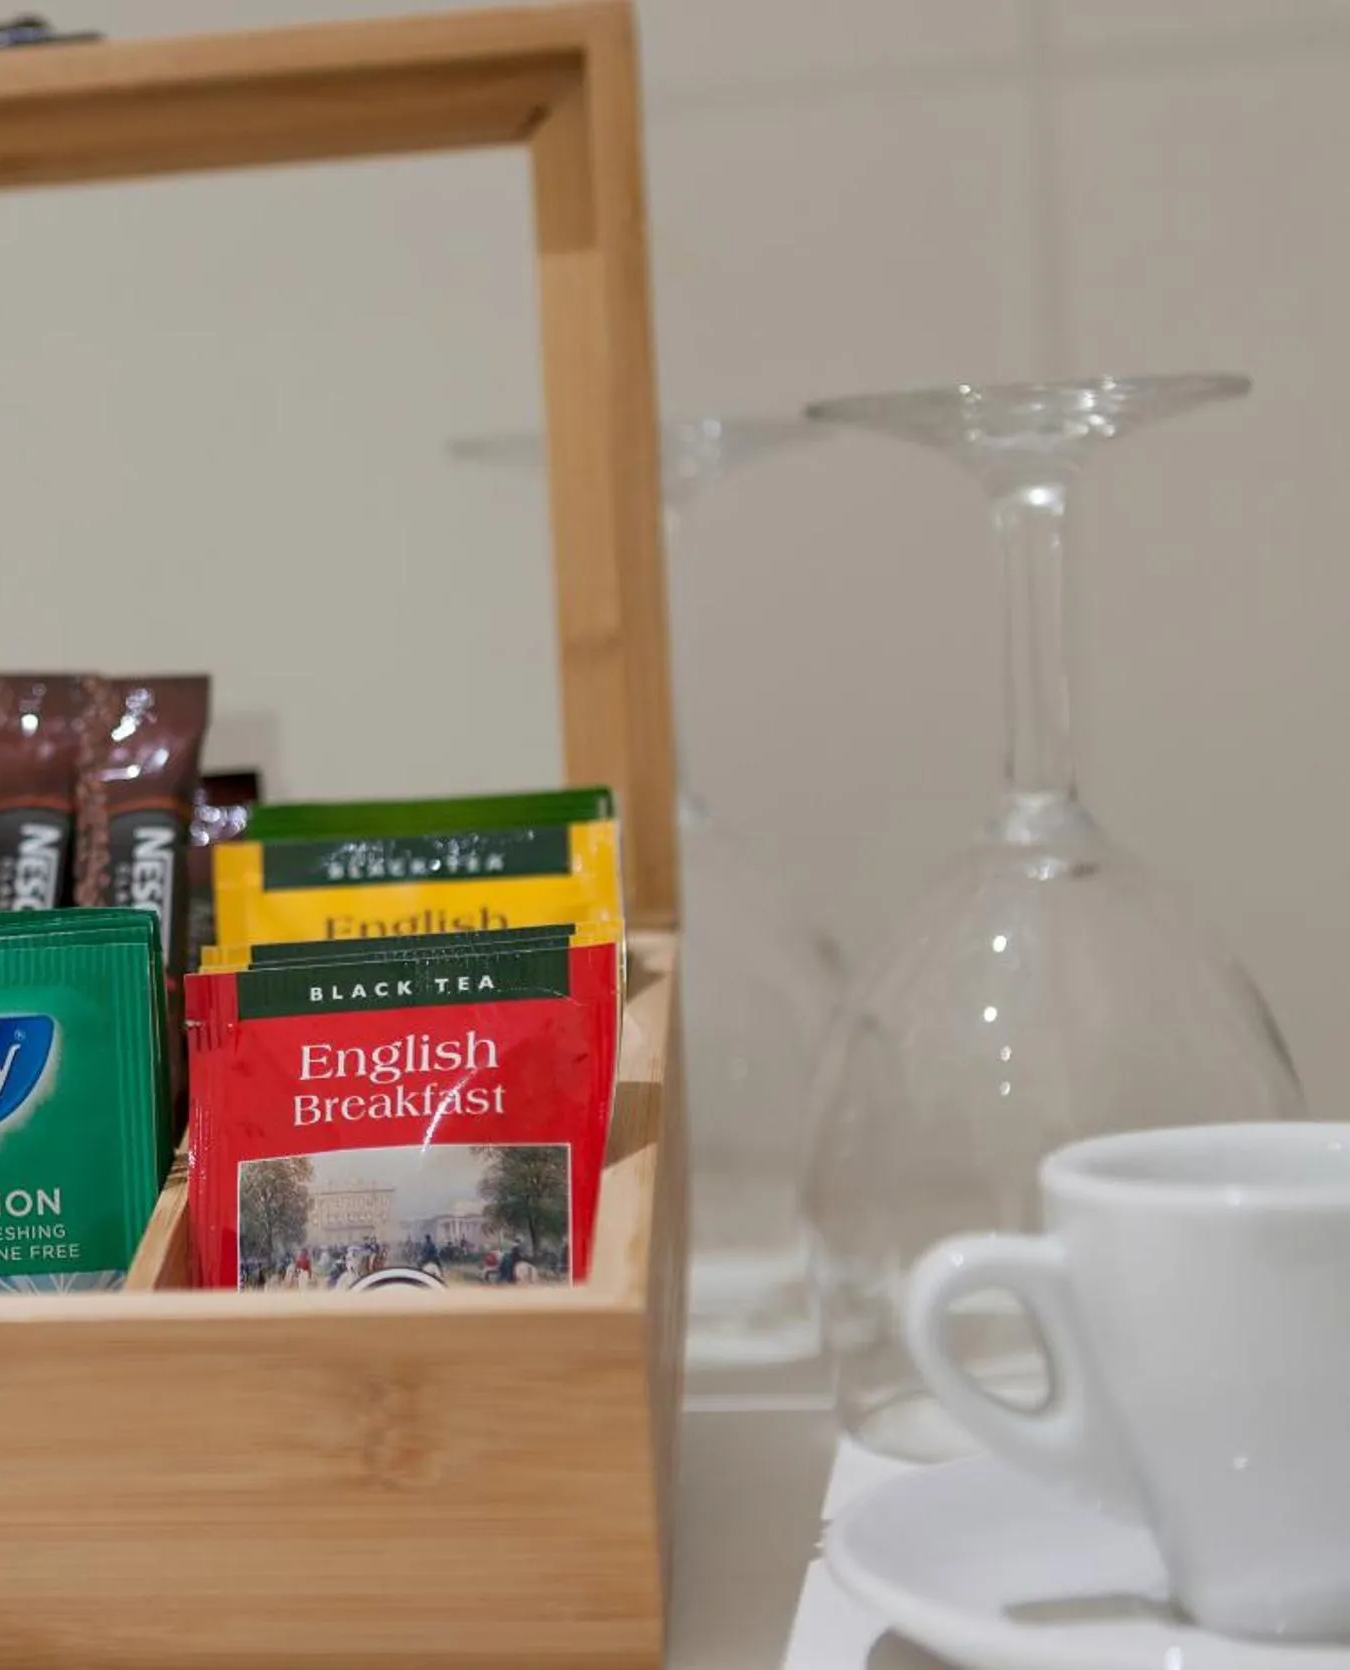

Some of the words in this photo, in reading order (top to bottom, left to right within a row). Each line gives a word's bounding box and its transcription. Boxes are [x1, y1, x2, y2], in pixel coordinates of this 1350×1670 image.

[310, 979, 413, 1001] BLACK
[435, 975, 495, 994] TEA
[299, 1030, 499, 1085] English
[293, 1082, 506, 1127] Breakfast
[29, 1243, 81, 1259] FREE
